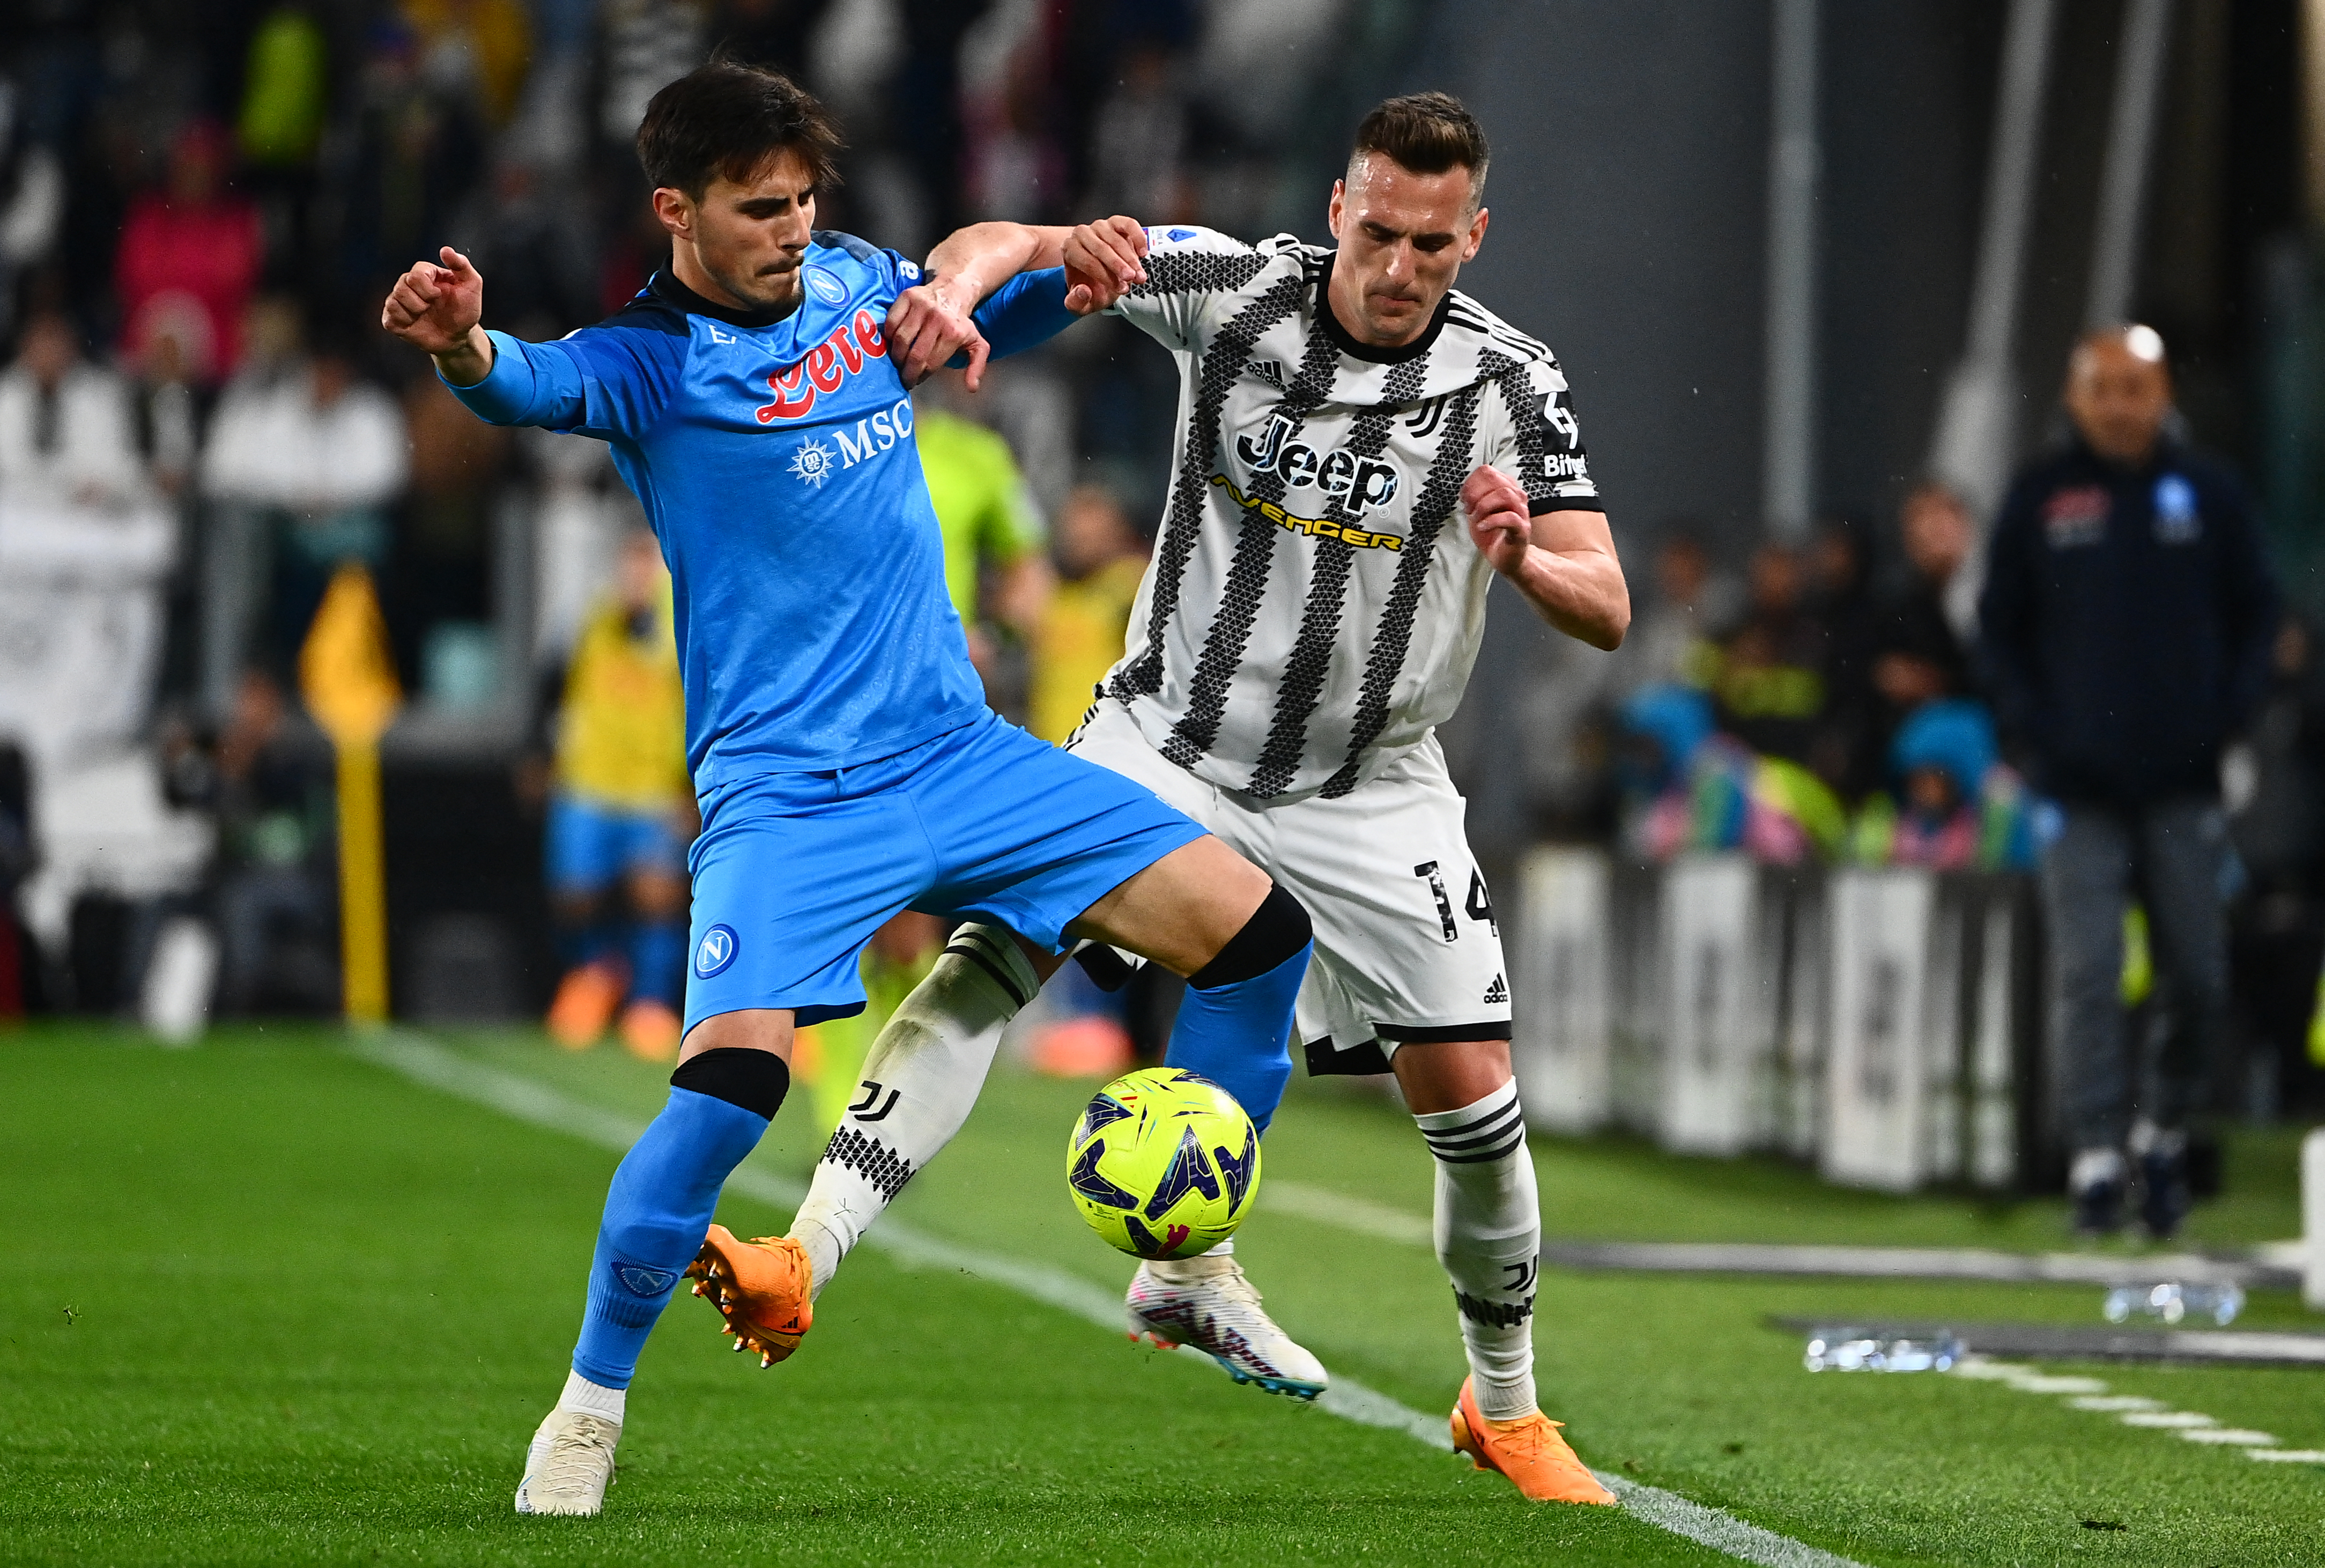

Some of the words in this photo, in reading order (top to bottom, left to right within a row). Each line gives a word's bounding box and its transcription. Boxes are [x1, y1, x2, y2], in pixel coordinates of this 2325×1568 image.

[1247, 364, 1287, 392] adidas
[832, 398, 912, 470] MSC
[1235, 413, 1401, 516] Jeep
[1209, 472, 1405, 552] AVENGER
[1413, 860, 1499, 943] 14
[701, 935, 725, 966] N
